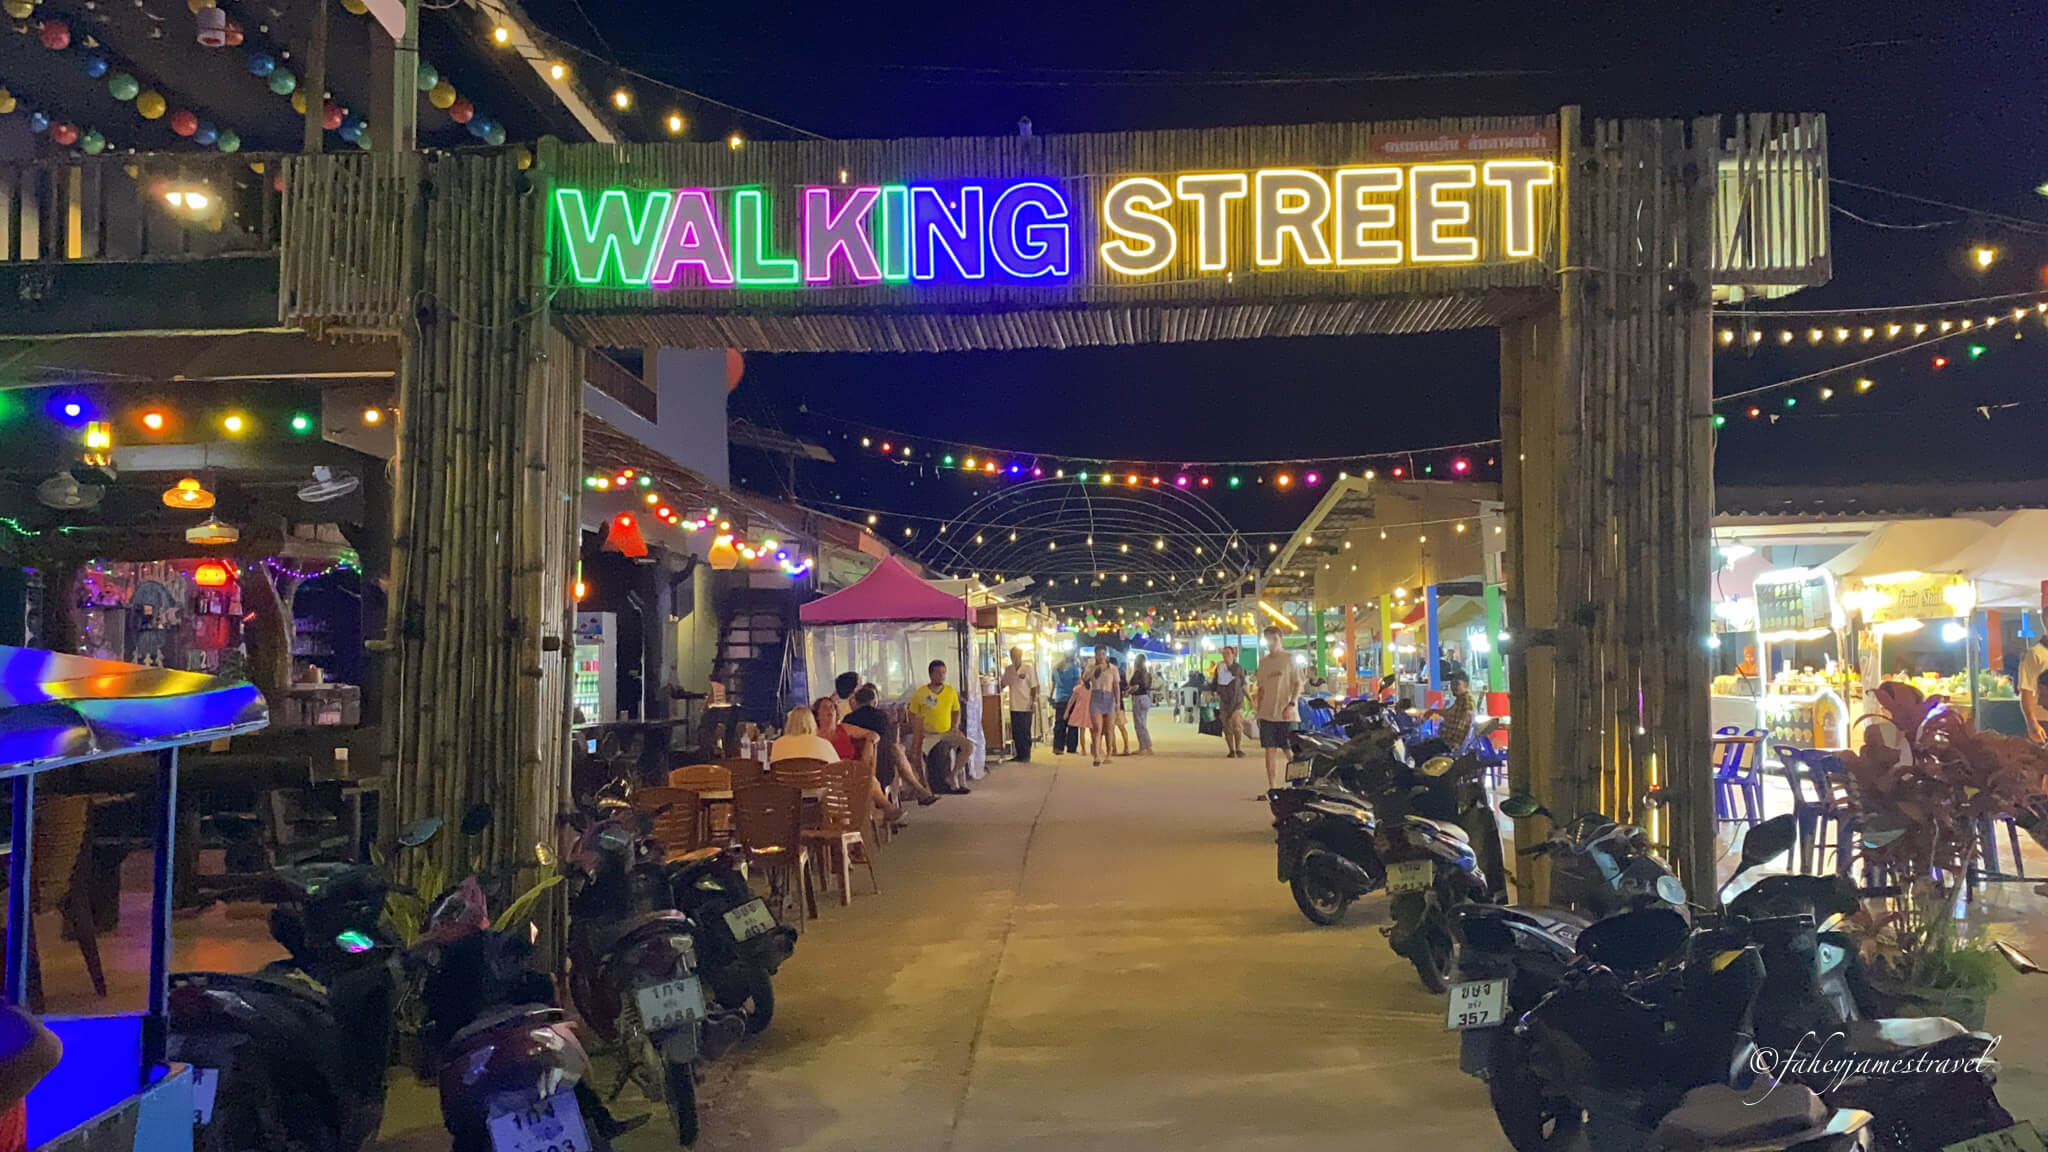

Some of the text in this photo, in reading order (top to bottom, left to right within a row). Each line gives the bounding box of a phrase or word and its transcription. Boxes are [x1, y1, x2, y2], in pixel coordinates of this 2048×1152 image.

[555, 160, 1555, 284] WALKING STREET
[1458, 1010, 1489, 1026] 357
